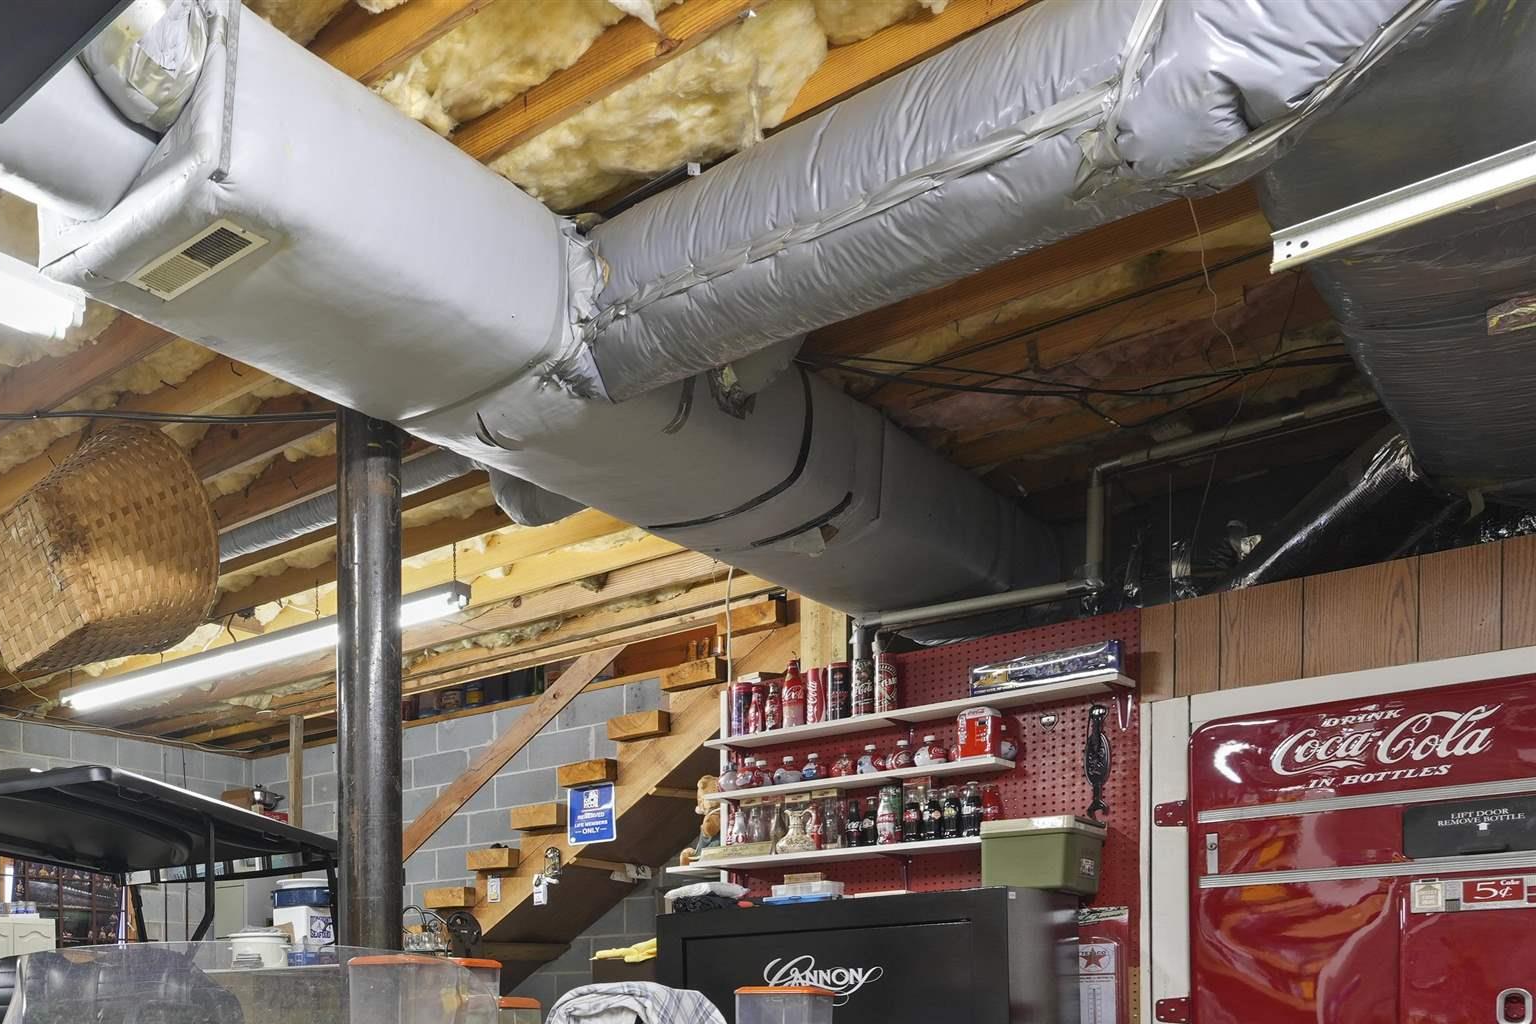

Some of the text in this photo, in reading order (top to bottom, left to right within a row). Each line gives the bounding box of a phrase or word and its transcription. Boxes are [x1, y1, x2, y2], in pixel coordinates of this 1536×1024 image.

[1321, 708, 1403, 727] DRINK
[1270, 703, 1505, 776] Coca-Cola
[1309, 764, 1452, 789] IN BOTTLES
[1437, 813, 1526, 827] REMOVE BOTTLE
[1451, 808, 1509, 820] LIFT DOOR
[1473, 882, 1512, 900] 5¢
